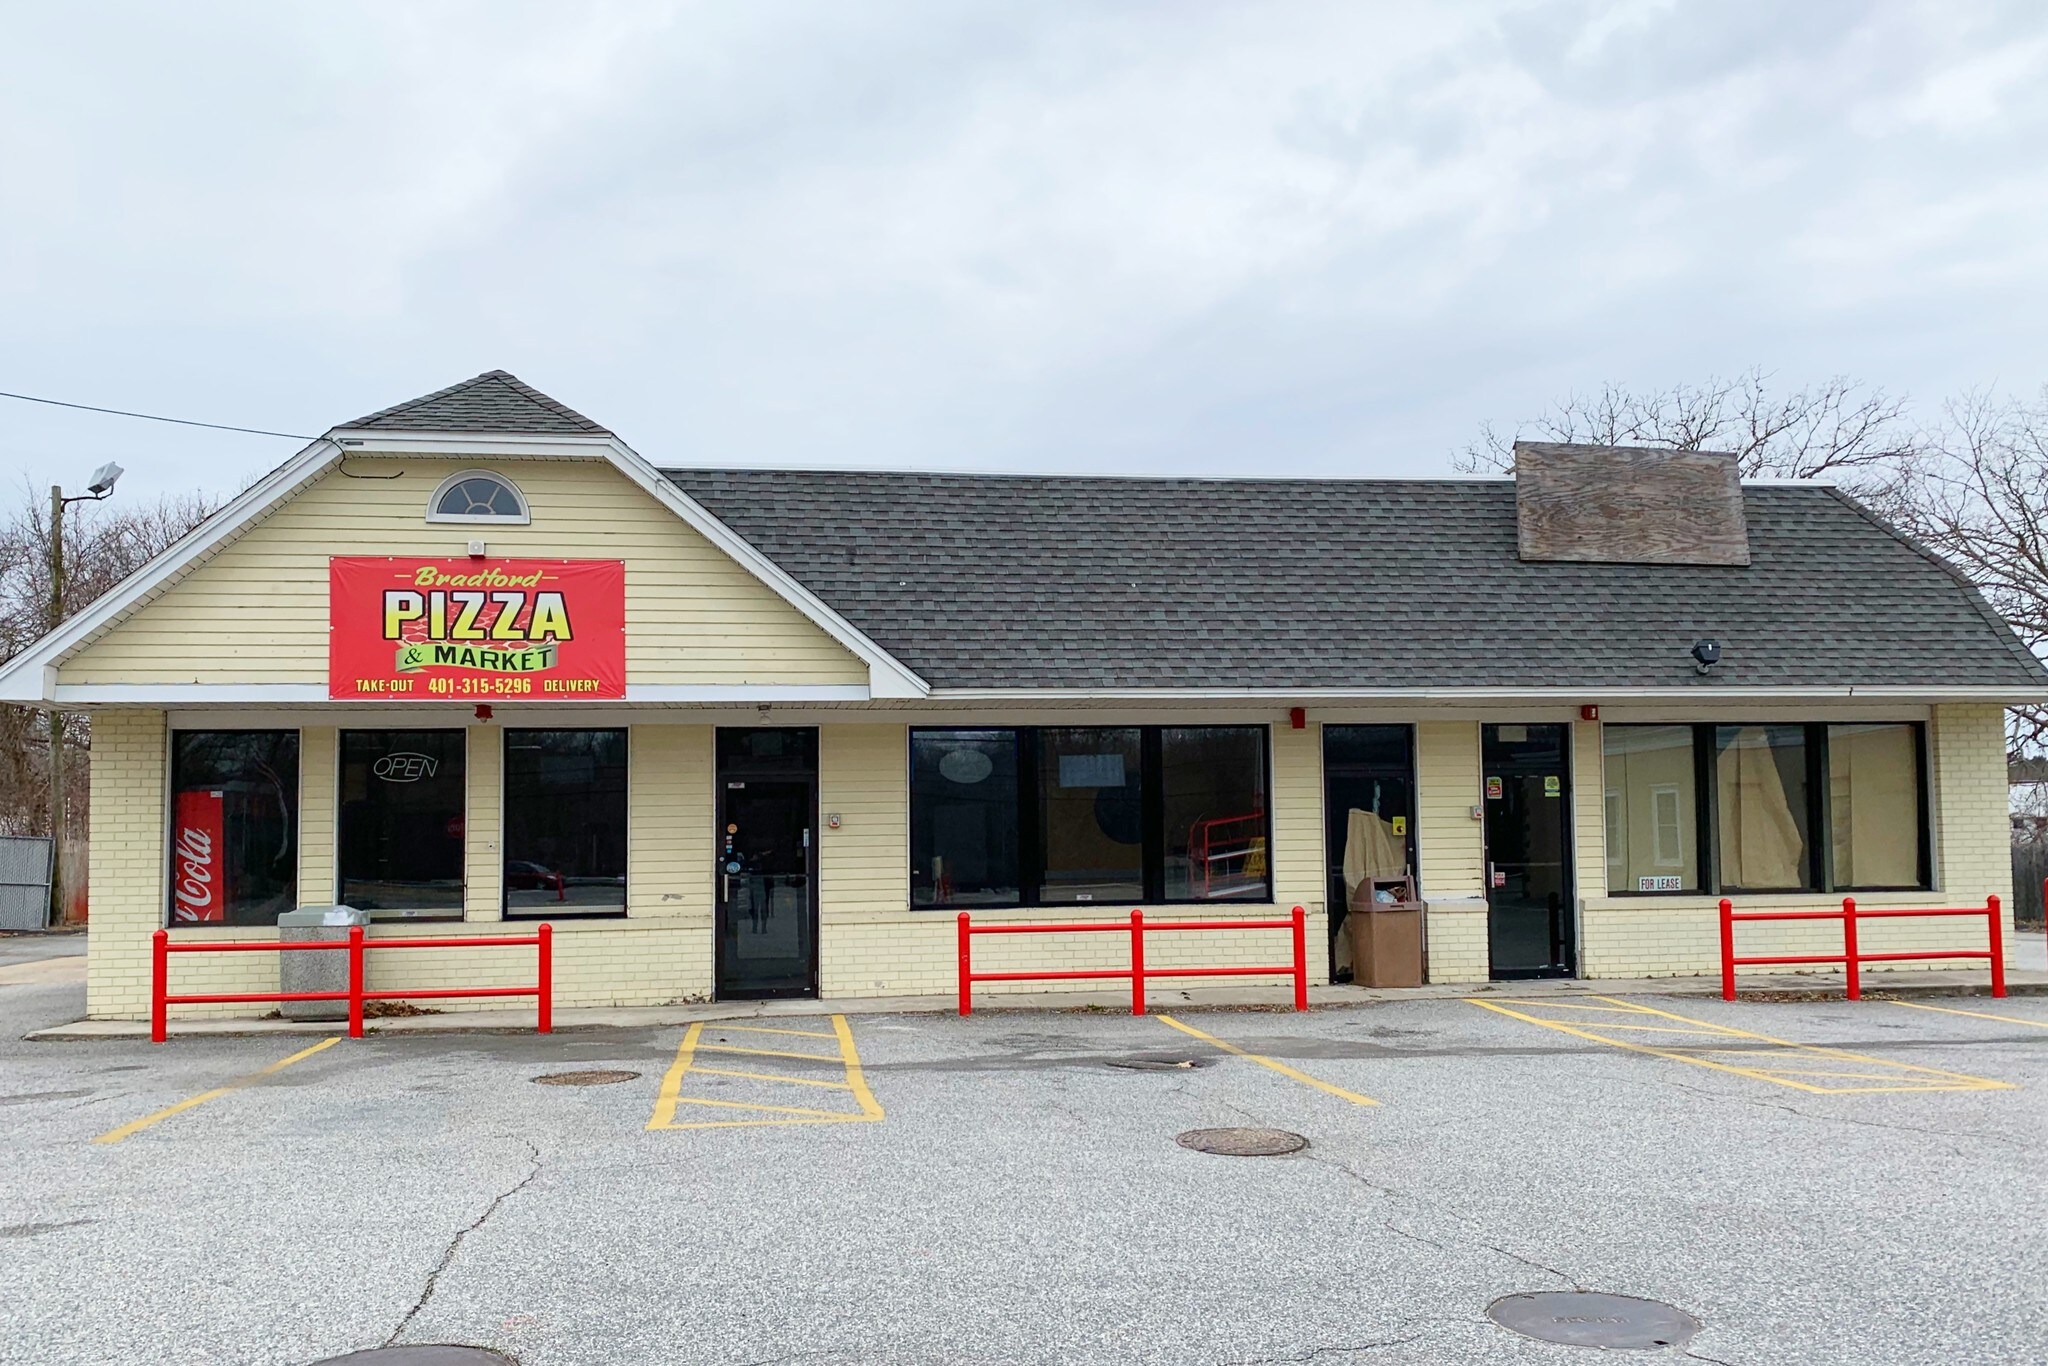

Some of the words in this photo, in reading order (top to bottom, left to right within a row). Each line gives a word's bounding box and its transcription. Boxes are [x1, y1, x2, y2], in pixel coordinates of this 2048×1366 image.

[414, 566, 544, 588] Bradford
[383, 589, 574, 641] PIZZA
[404, 648, 424, 665] &
[434, 645, 553, 671] MARKET
[355, 679, 414, 692] TAKE-OUT
[428, 677, 532, 694] 401-315-5296
[543, 679, 600, 692] DELIVERY
[373, 756, 439, 779] OPEN
[1641, 878, 1655, 890] FOR
[1657, 877, 1680, 889] LEASE
